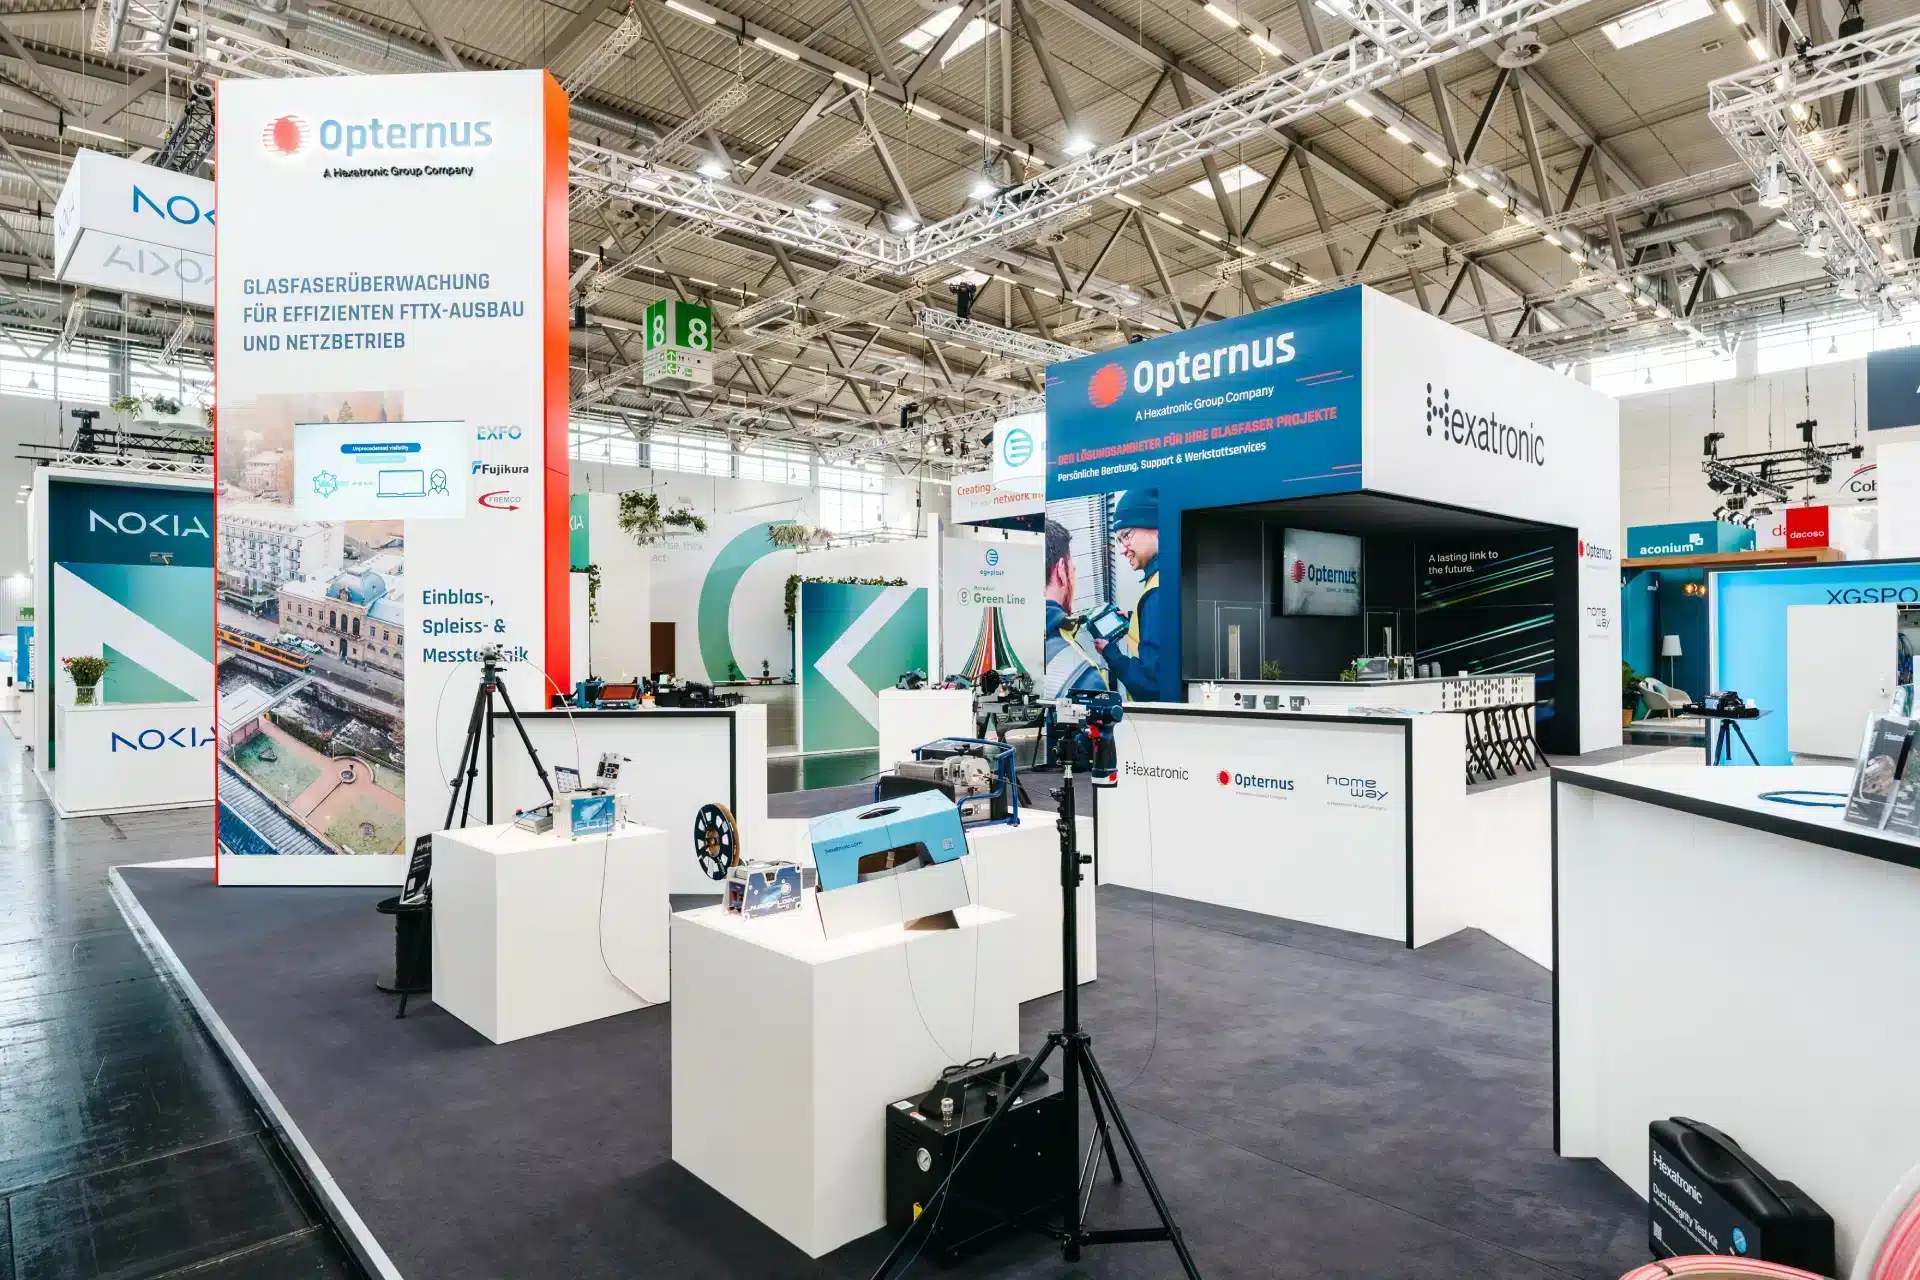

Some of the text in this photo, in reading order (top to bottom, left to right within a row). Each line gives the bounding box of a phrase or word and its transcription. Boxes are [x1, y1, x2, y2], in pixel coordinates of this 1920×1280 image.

[319, 118, 494, 157] Opternus
[323, 165, 474, 178] A Hexatronic Group Company
[243, 272, 490, 295] GLASFASERÜBERWACHUNG
[243, 300, 525, 323] FÜR EFFIZIENTEN FTTX-AUSBAU
[653, 315, 665, 347] 8
[688, 318, 708, 350] 8
[243, 332, 406, 352] UND NETZBETRIEB
[1133, 331, 1296, 397] Opternus
[1135, 385, 1275, 421] A Hexatronic Group Company
[476, 425, 522, 441] EXFO
[1426, 382, 1545, 467] Hexatronic
[1058, 451, 1075, 466] DER
[1163, 431, 1183, 447] FÜR
[1184, 429, 1209, 443] IHRE
[1211, 418, 1274, 440] GLASFASER
[1275, 406, 1337, 428] PROJEKTE
[481, 463, 529, 476] Fujikura
[1057, 441, 1267, 482] Persönliche Beratung, Support & Werkstattservices
[957, 483, 991, 496] Creating
[993, 492, 1030, 504] network
[488, 496, 522, 504] FREMCO
[89, 508, 210, 539] NOKIA
[1790, 529, 1825, 539] dacoso
[1428, 551, 1499, 565] A lasting link to
[1639, 542, 1694, 555] aconium
[1307, 563, 1357, 585] Opternus
[1428, 565, 1475, 575] the future.
[422, 588, 494, 606] Einblas-,
[973, 593, 1026, 605] Green Line
[1826, 586, 1919, 604] XGSPO
[422, 617, 506, 636] Spleiss- &
[1125, 760, 1189, 780] Hexatronic
[1234, 773, 1295, 791] Opternus
[1326, 774, 1377, 789] home
[1350, 787, 1389, 801] way
[1653, 1150, 1703, 1205] Hexatronic
[1652, 1182, 1667, 1201] Duct
[1667, 1195, 1693, 1228] Integrity
[1693, 1218, 1708, 1238] Test
[1708, 1231, 1719, 1250] Kit
